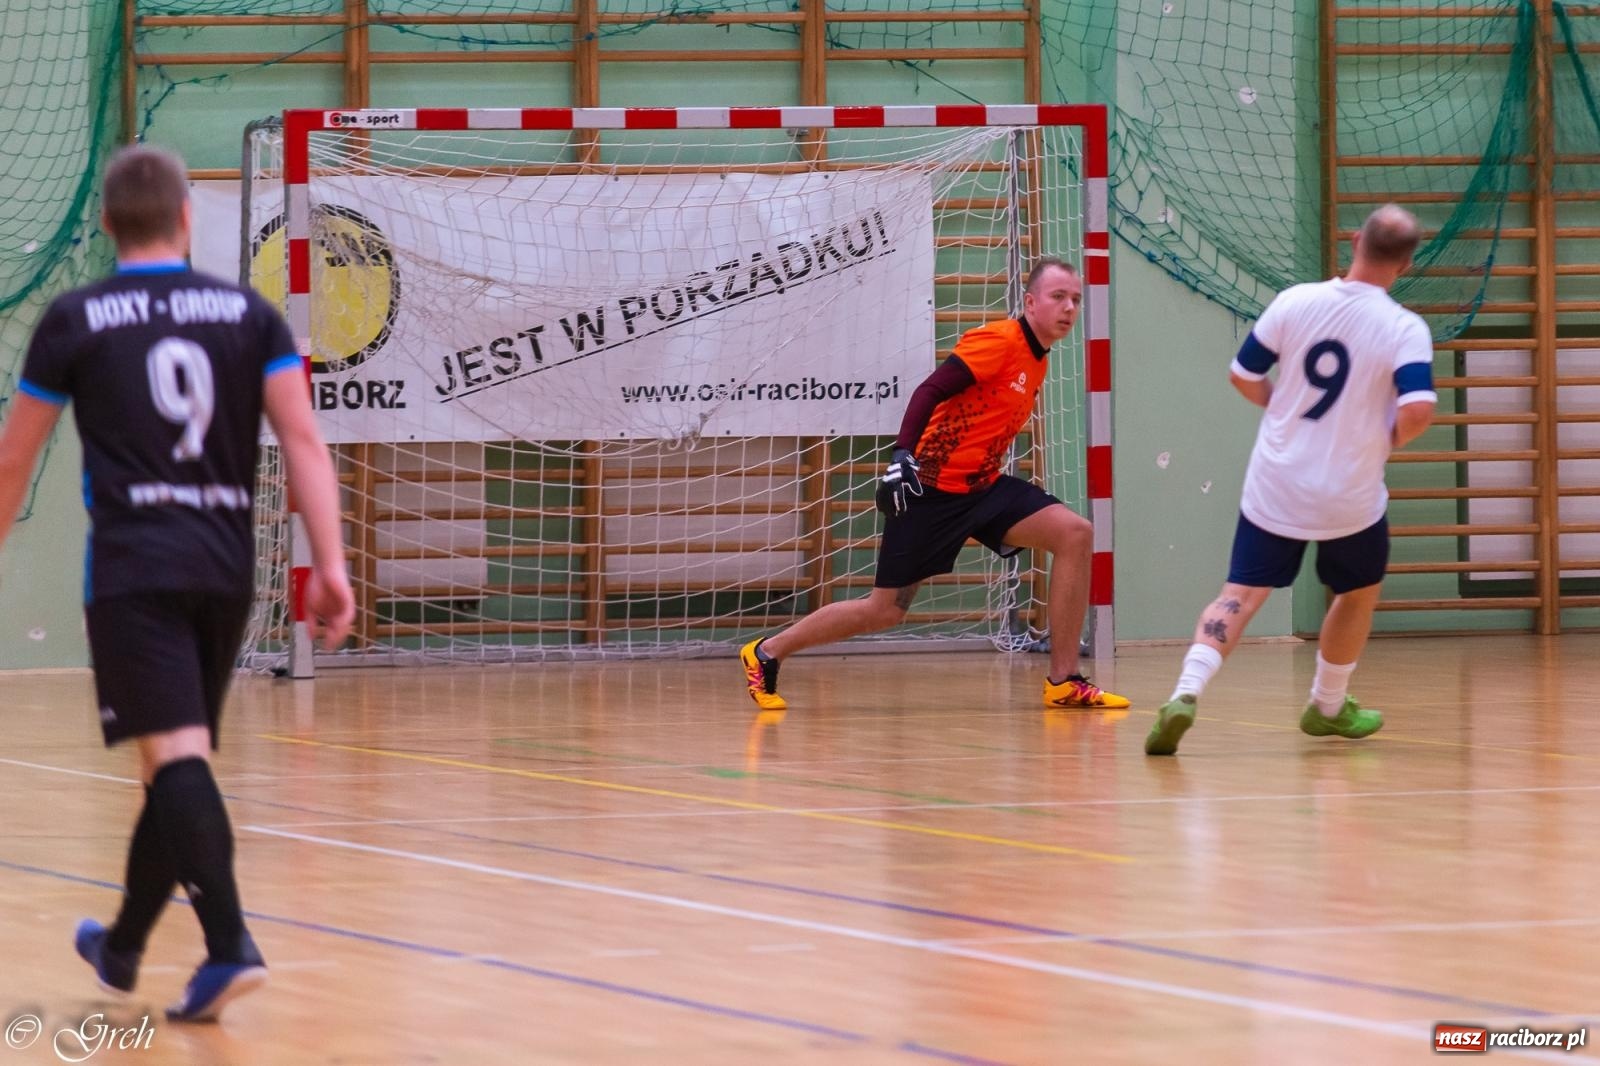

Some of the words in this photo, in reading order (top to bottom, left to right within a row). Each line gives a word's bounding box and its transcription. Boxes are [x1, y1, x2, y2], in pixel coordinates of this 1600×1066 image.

[366, 114, 399, 126] sport
[169, 288, 248, 325] GROUP
[435, 324, 545, 396] JEST
[558, 305, 605, 352] W
[1302, 338, 1350, 421] 9
[147, 337, 214, 460] 9
[621, 376, 898, 404] www.osir-raciborz.pl
